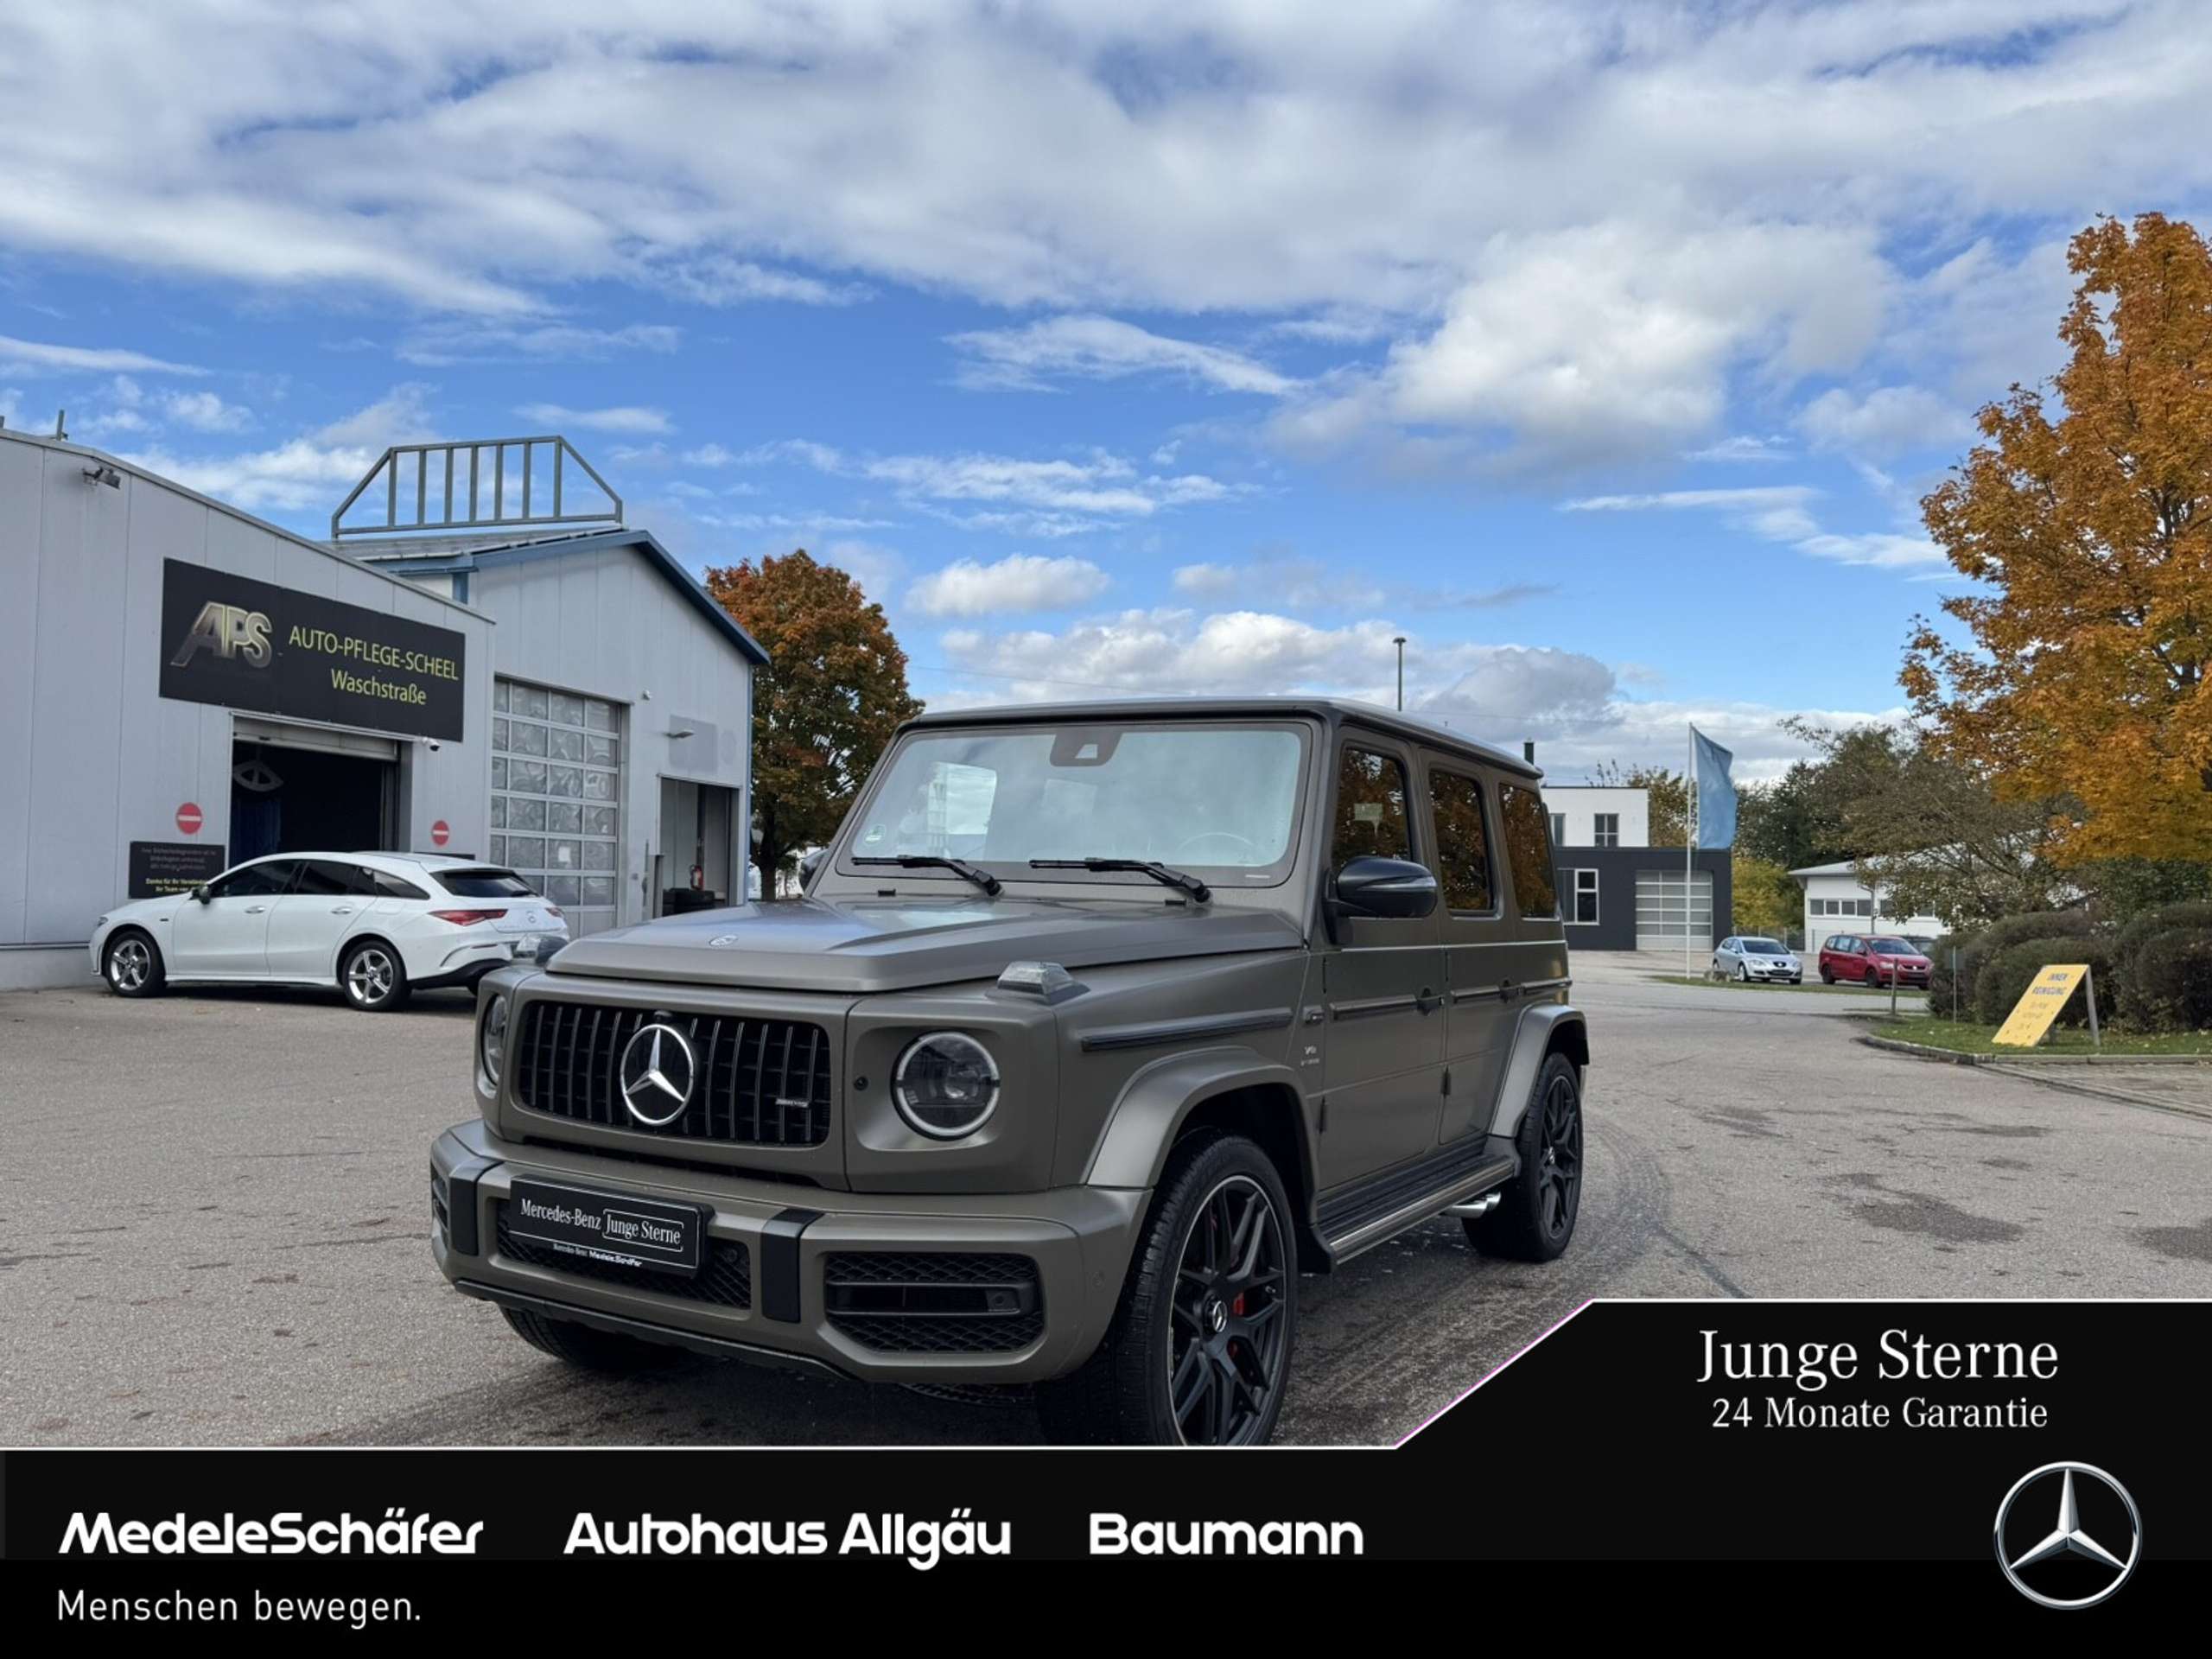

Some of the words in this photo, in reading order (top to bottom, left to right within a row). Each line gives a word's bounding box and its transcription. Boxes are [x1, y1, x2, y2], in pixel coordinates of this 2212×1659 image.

[171, 601, 273, 669] APS
[289, 626, 459, 680] AUTO-PFLEGE-SCHEEL
[331, 668, 427, 705] Waschstraße
[520, 1198, 601, 1230] Mercedes-Benz
[605, 1214, 639, 1239] Junge
[641, 1220, 681, 1244] Sterne
